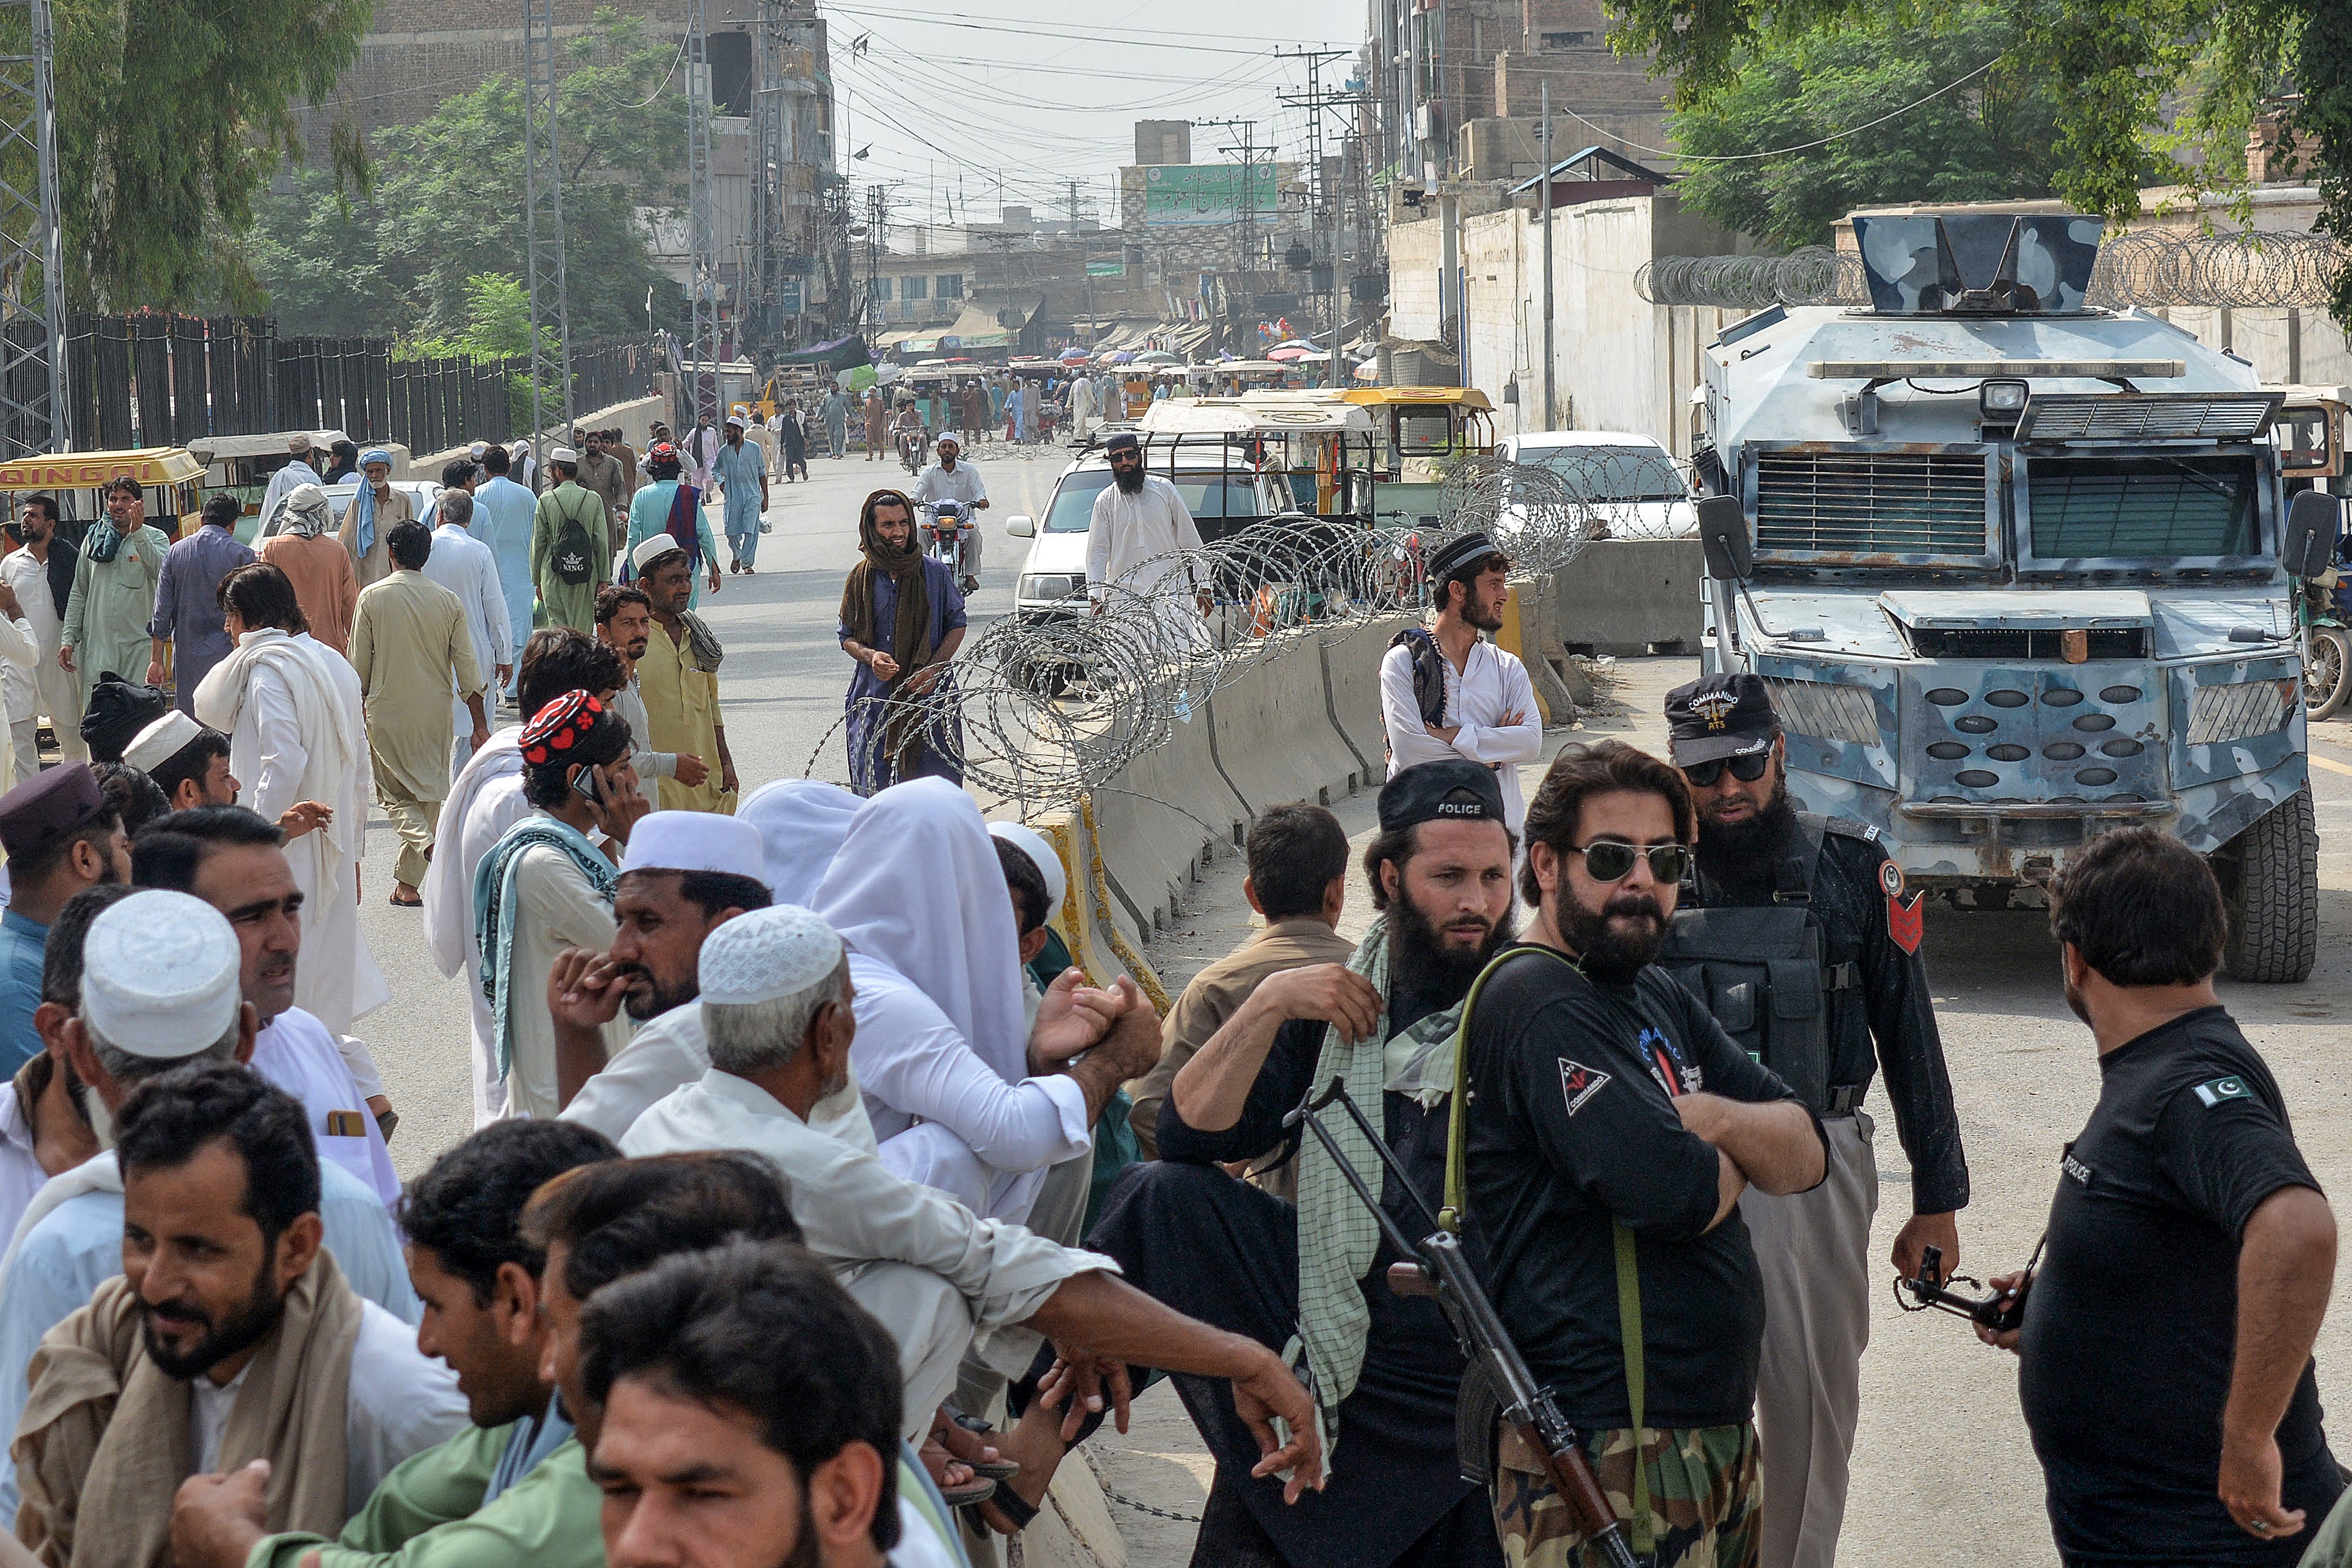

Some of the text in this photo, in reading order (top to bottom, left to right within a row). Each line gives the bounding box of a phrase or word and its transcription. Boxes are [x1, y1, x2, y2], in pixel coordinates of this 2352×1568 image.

[1689, 690, 1738, 710] COMMANDO
[1708, 721, 1726, 731] ATS
[1438, 803, 1481, 814] POLICE
[1570, 1075, 1604, 1108] COMMANDO
[2065, 1158, 2091, 1183] POLICE
